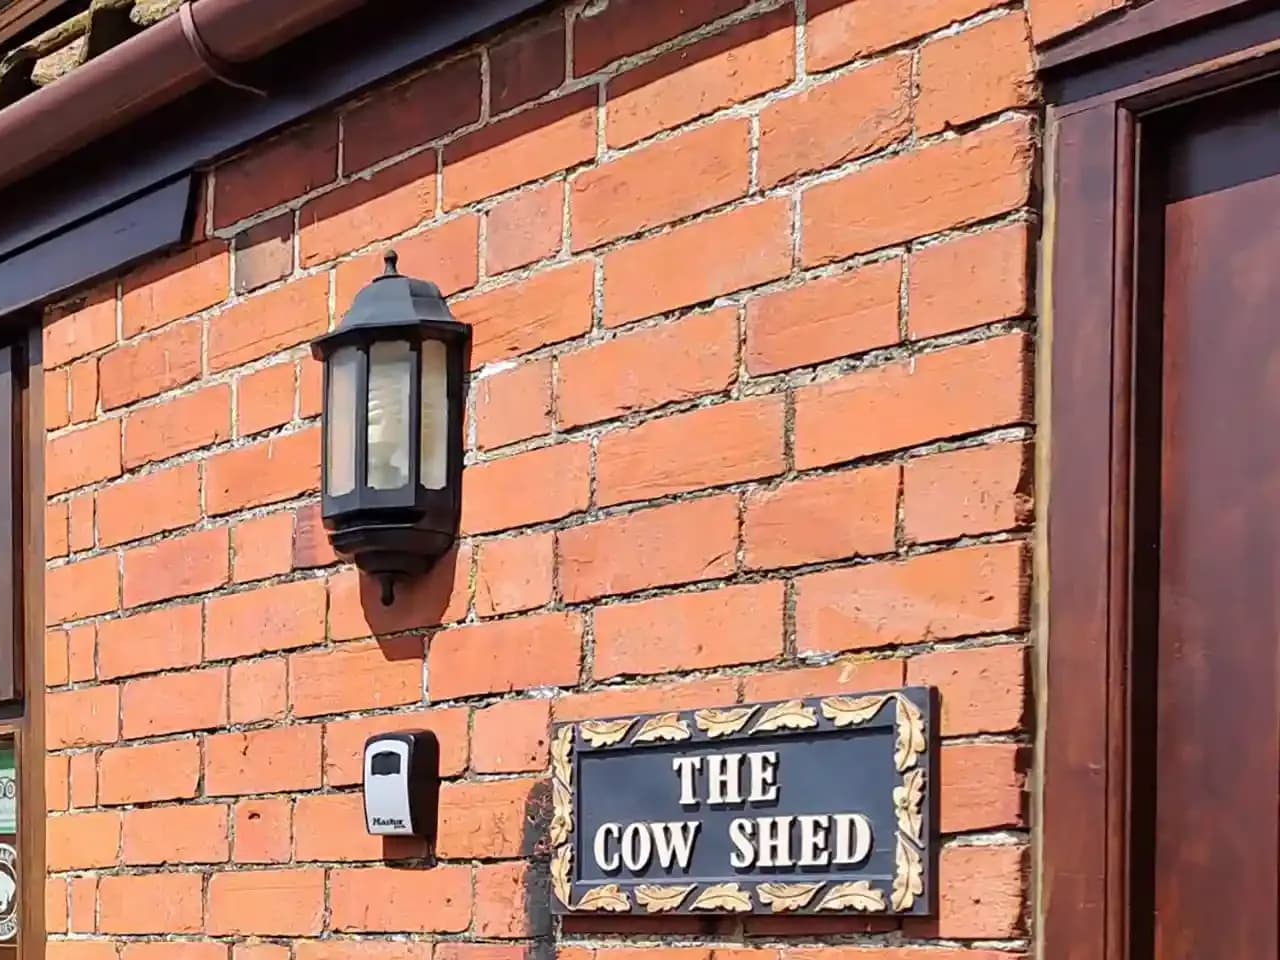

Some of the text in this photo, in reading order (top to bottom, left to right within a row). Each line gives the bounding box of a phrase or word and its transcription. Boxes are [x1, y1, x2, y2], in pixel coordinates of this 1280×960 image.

[673, 751, 780, 805] THE
[593, 813, 874, 872] COW SHED
